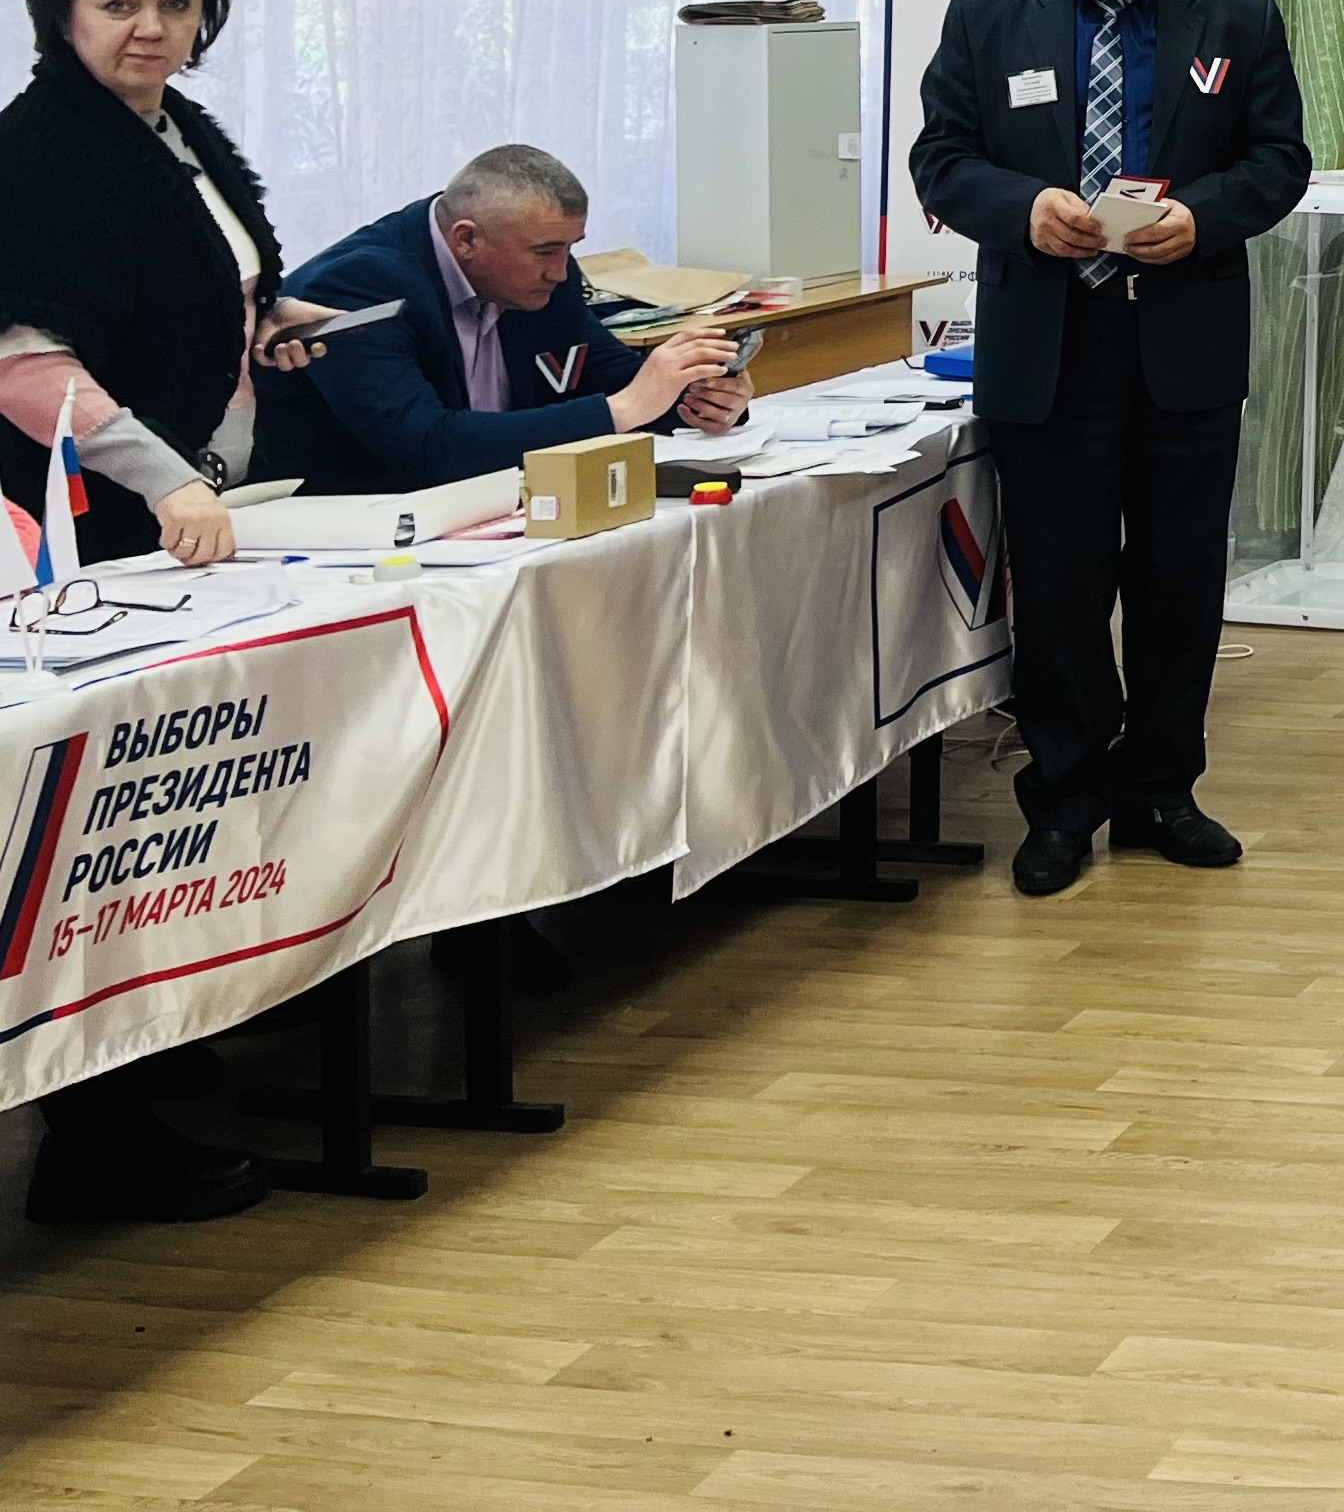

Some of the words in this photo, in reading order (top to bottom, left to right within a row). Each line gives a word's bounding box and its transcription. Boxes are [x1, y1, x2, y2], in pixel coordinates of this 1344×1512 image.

[103, 694, 268, 769] ВЫБОРЫ
[82, 741, 312, 836] ПРЕЗИДЕНТА
[61, 819, 219, 903] РОССИИ
[118, 875, 218, 935] МАРТА
[218, 858, 287, 909] 2024
